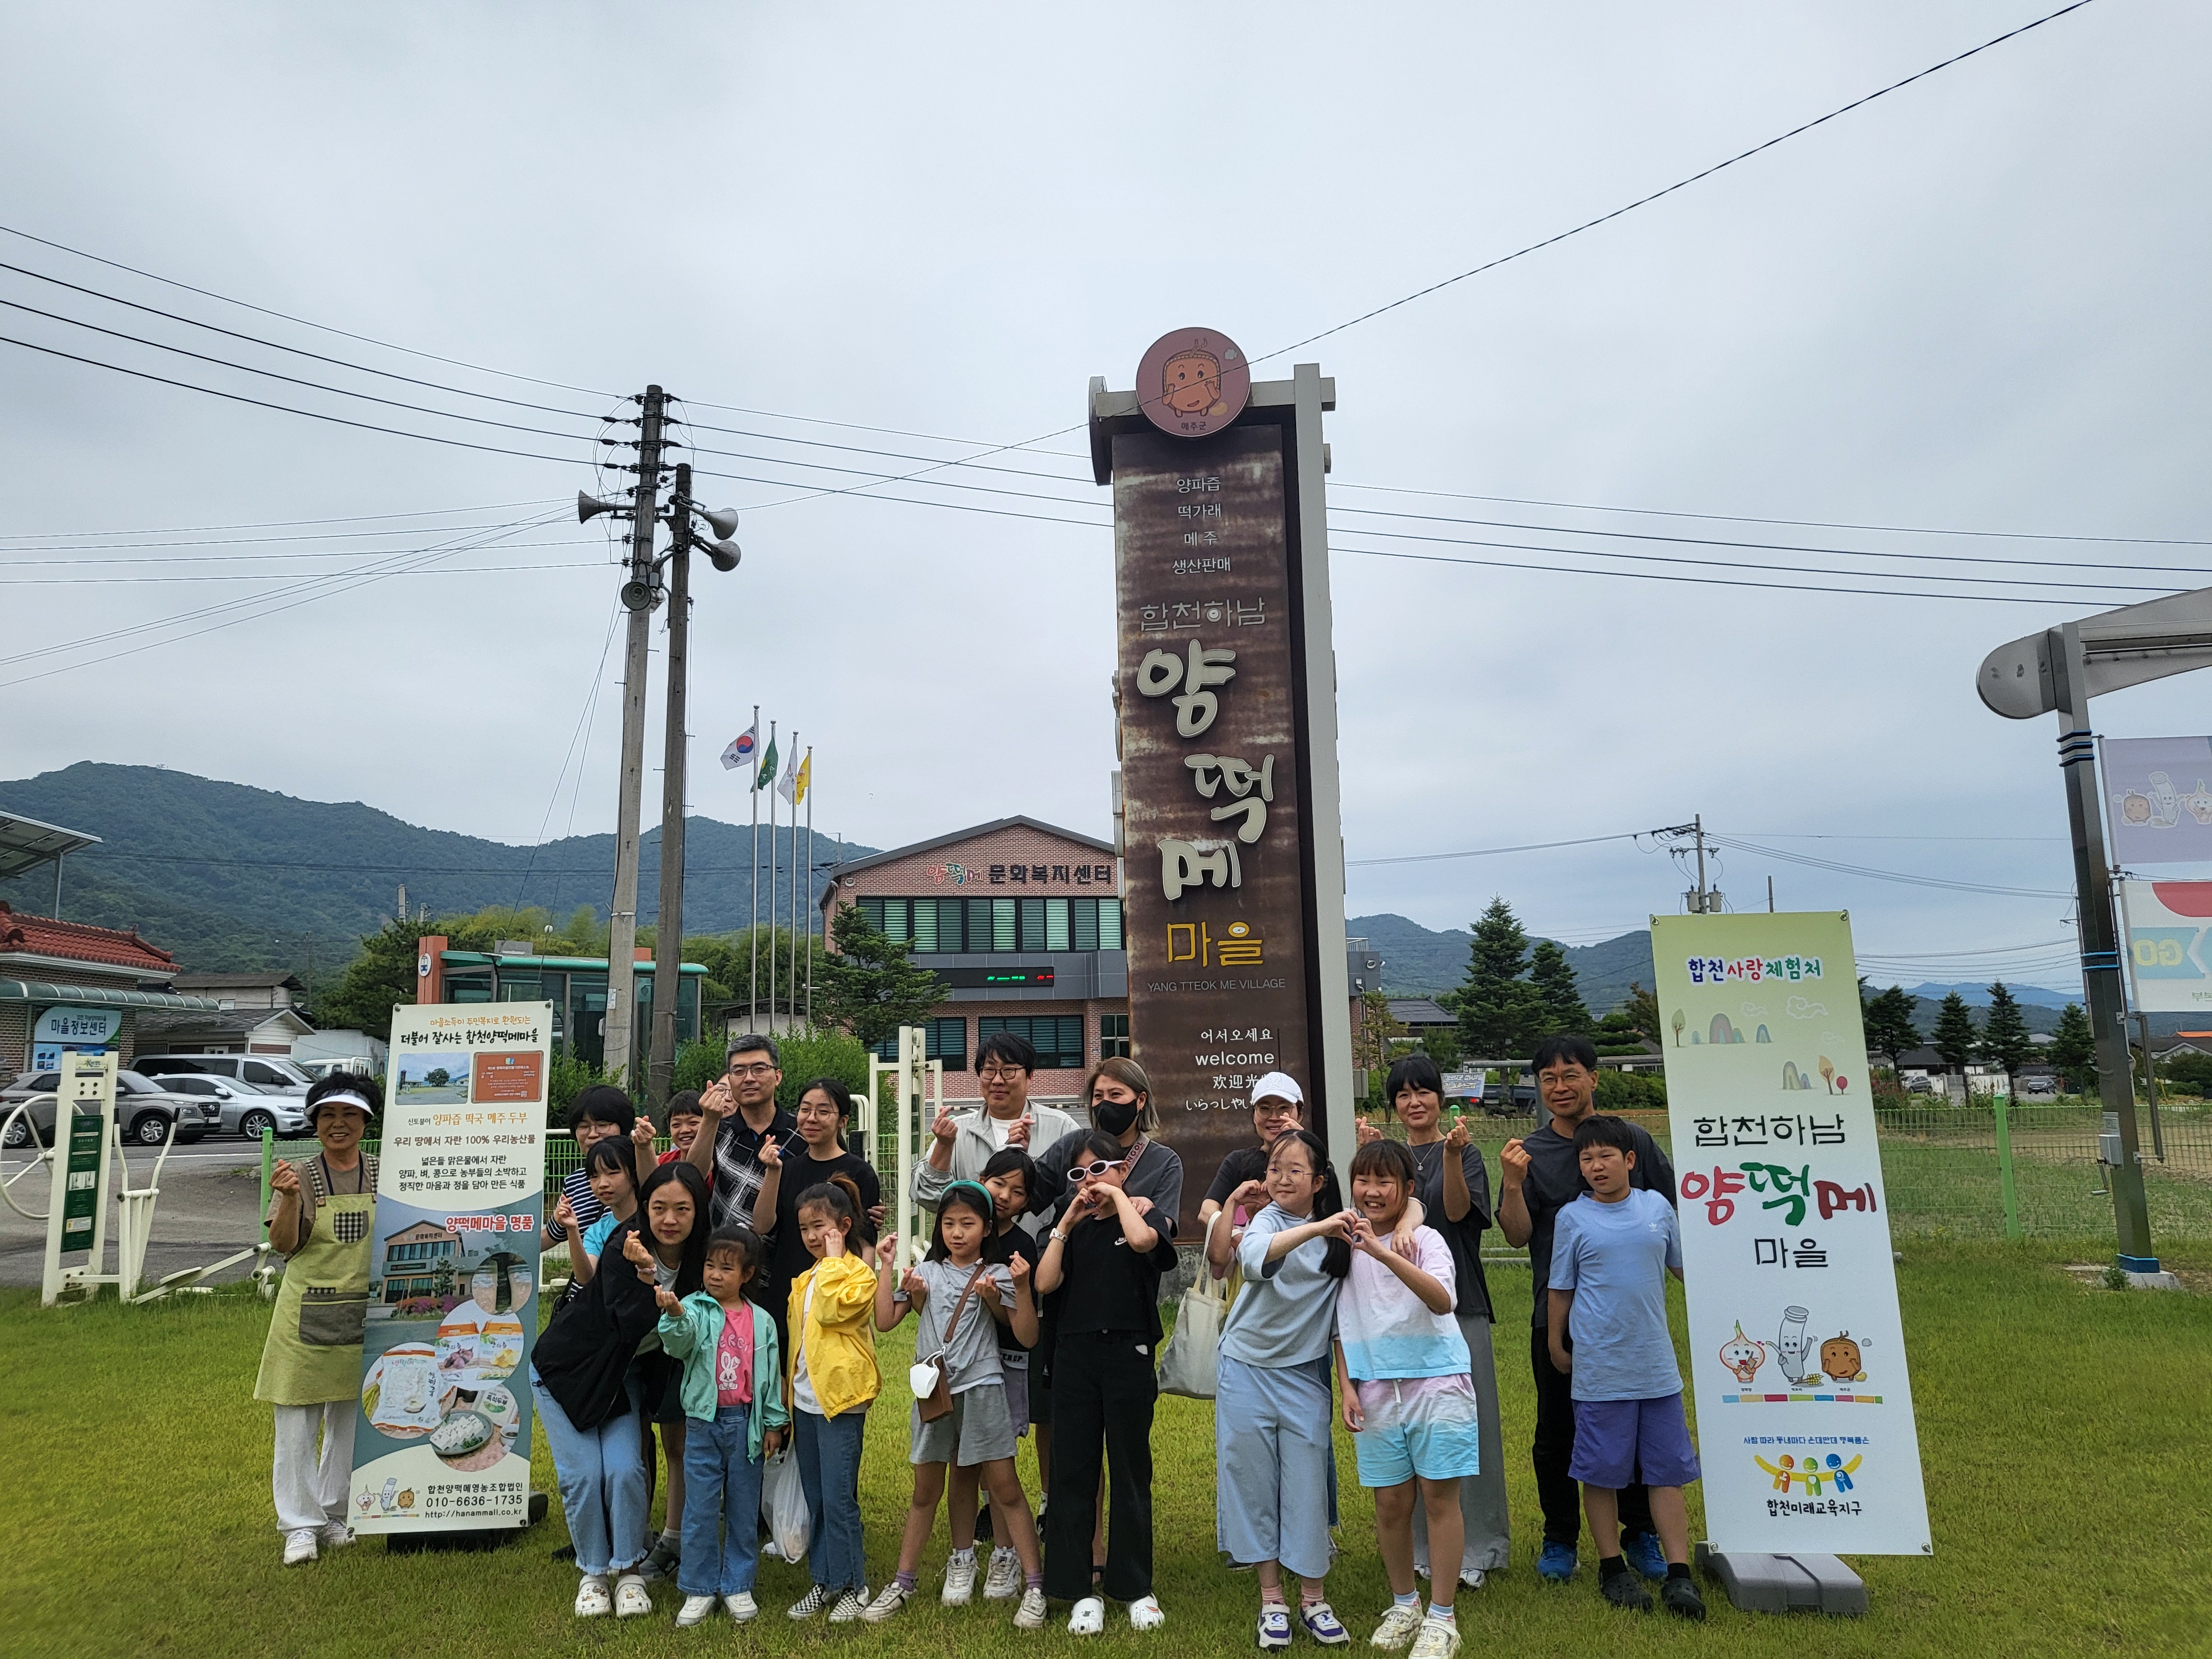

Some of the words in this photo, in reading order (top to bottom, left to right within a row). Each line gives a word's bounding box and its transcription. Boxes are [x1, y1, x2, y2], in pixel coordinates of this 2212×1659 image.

[1181, 421, 1206, 431] 메주군
[1176, 477, 1222, 493] 양파즙
[1178, 503, 1222, 519] 떡가래
[1172, 557, 1232, 575] 생산판매
[1140, 597, 1266, 632] 합천하남
[927, 863, 984, 885] 양떡메
[989, 864, 1112, 885] 문화복지센터
[1167, 921, 1264, 967] 마을
[1147, 982, 1177, 992] YANG
[1180, 980, 1217, 991] TTEOK
[1220, 980, 1237, 989] ME
[1239, 979, 1286, 989] VILLAGE
[51, 1017, 107, 1036] 마을정보센터
[466, 1016, 499, 1025] 주민복지로
[502, 1015, 531, 1025] 환원되는
[400, 1031, 428, 1046] 더불어
[432, 1031, 462, 1045] 잘사는
[466, 1027, 539, 1045] 합천양떡메마을
[1201, 1027, 1274, 1044] 어서오세요
[1195, 1051, 1275, 1066] welcome
[1212, 1073, 1266, 1089] 欢迎光
[433, 1113, 462, 1125] 양파즙
[465, 1113, 484, 1124] 떡국
[507, 1113, 528, 1124] 두부
[1693, 1113, 1845, 1147] 합천하남
[393, 1137, 411, 1147] 우리
[415, 1136, 441, 1146] 땅에서
[445, 1136, 462, 1145] 자란
[465, 1135, 490, 1145] 100%
[492, 1134, 536, 1145] 우리농산물
[421, 1156, 446, 1166] 넓은들
[447, 1156, 487, 1165] 맑은물에서
[490, 1155, 507, 1165] 자란
[399, 1169, 418, 1179] 양파,
[420, 1169, 430, 1178] 벼,
[433, 1168, 457, 1178] 콩으로
[460, 1168, 492, 1178] 농부들의
[494, 1167, 527, 1177] 소박하고
[399, 1182, 424, 1192] 정직한
[426, 1181, 451, 1191] 마음과
[453, 1181, 469, 1191] 정을
[472, 1180, 488, 1190] 담아
[491, 1180, 507, 1189] 만든
[510, 1179, 526, 1189] 식품
[1681, 1162, 1877, 1227] 양떡메
[446, 1215, 507, 1233] 양떡메마을
[509, 1215, 534, 1230] 명품
[1755, 1237, 1829, 1269] 마을
[1743, 1436, 1758, 1444] 사람
[1759, 1436, 1775, 1444] 따라
[1776, 1436, 1806, 1444] 동네마다
[427, 1483, 523, 1494] 합천양떡메영농조합법인
[426, 1495, 523, 1508] 010-6636-1735
[1766, 1499, 1863, 1516] 합천미래교육지구
[425, 1509, 522, 1519] http://hanammall.co.kr
